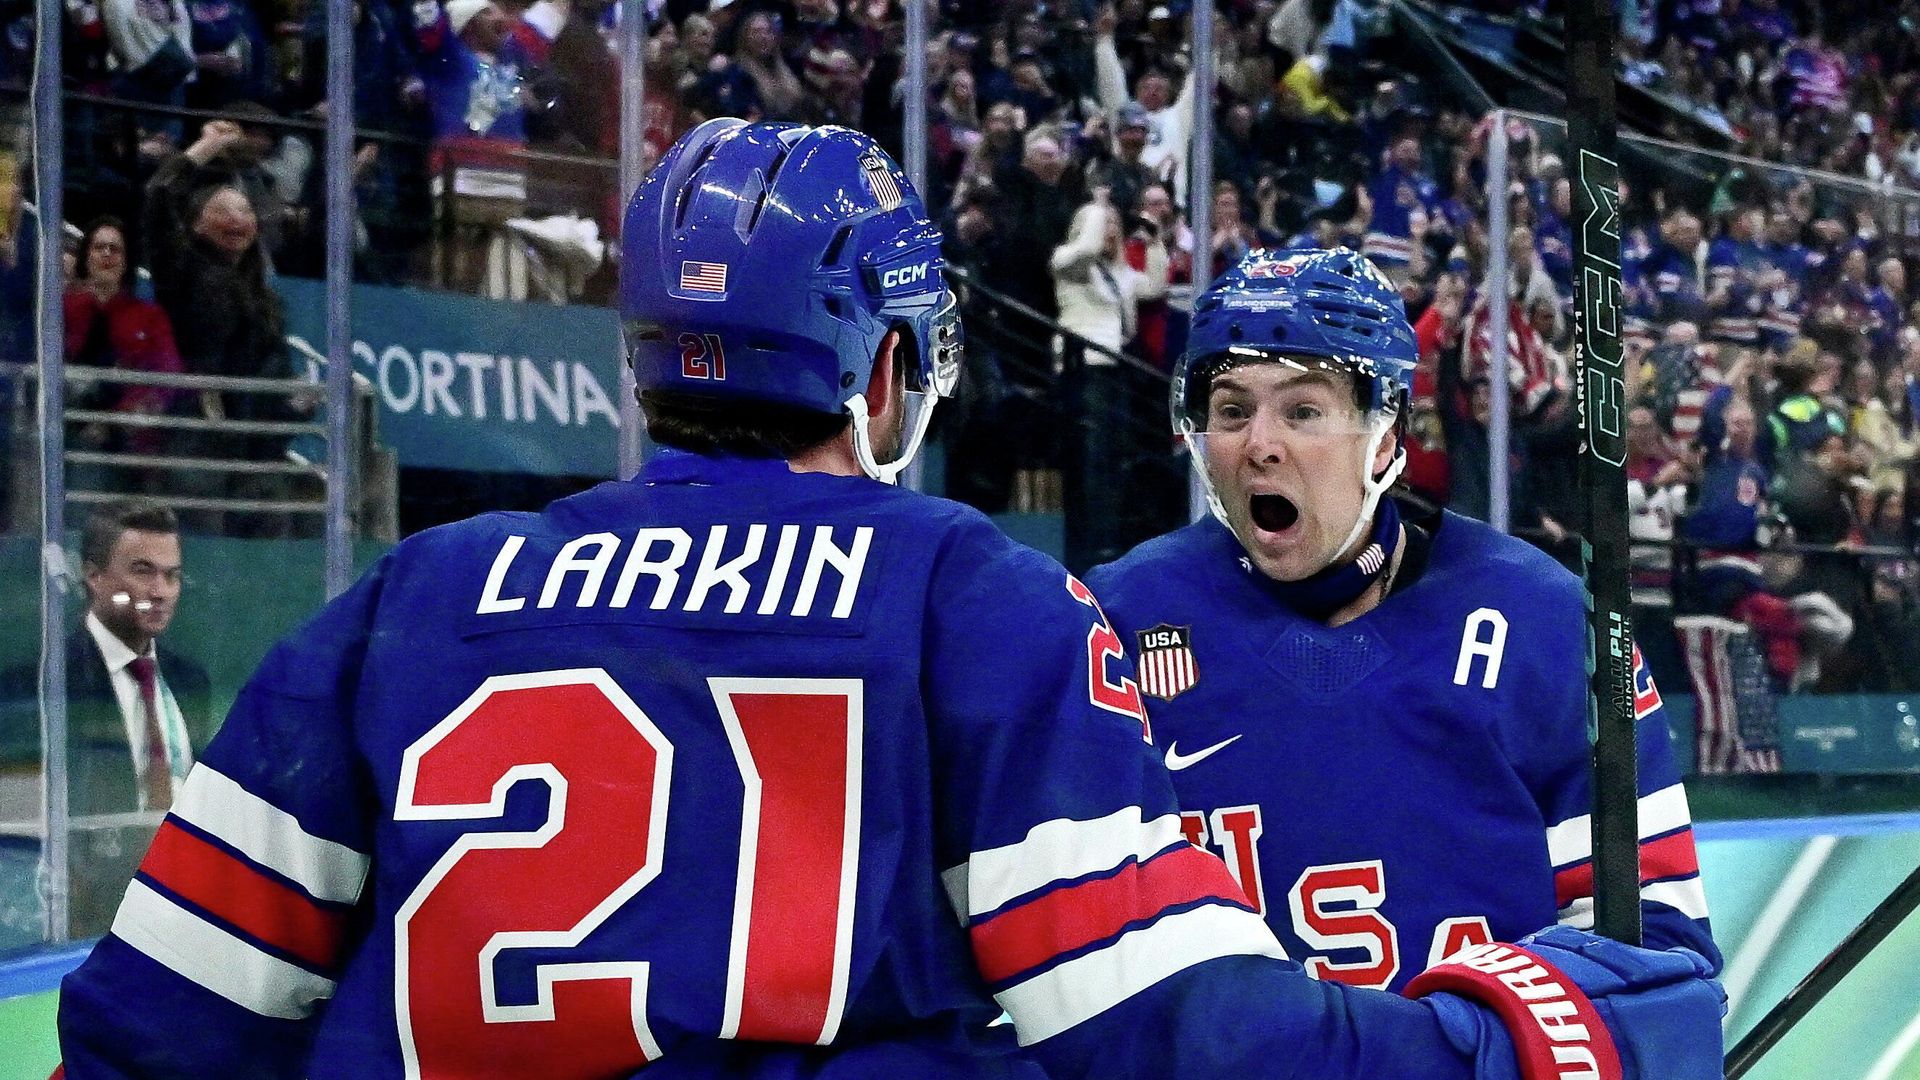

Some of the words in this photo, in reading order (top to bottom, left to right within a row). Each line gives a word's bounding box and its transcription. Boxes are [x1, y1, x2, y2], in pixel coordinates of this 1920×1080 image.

[861, 156, 882, 170] USA
[883, 261, 928, 288] CCM
[1575, 311, 1582, 335] 71
[1580, 148, 1629, 468] CCM
[678, 332, 726, 380] 21
[1576, 343, 1585, 429] LARKIN
[476, 524, 874, 619] LARKIN
[1144, 631, 1182, 648] USA
[1453, 607, 1508, 689] A
[393, 667, 864, 1080] 21
